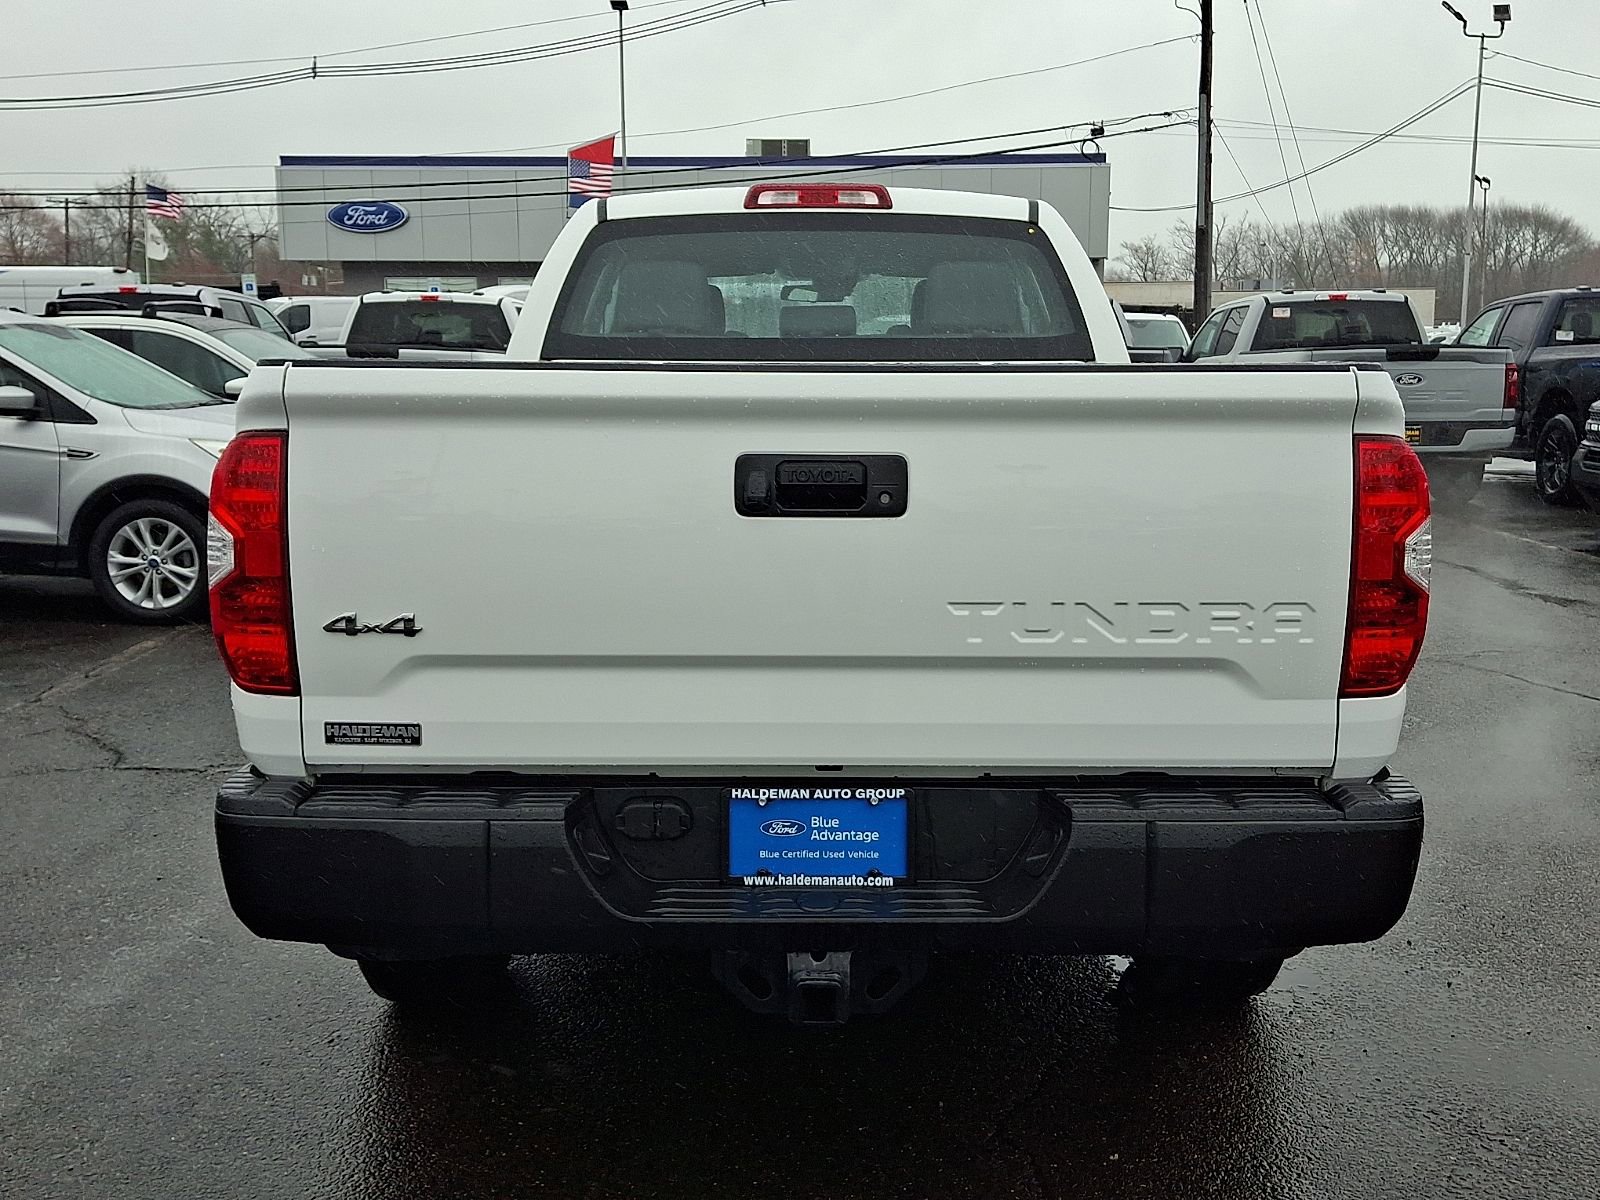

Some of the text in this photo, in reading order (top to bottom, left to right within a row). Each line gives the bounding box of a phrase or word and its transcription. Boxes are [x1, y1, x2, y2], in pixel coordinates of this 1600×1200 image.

[343, 205, 388, 225] Ford
[784, 469, 858, 483] TOYOTA
[947, 601, 1317, 644] TUNDRA
[326, 724, 420, 738] HALDEMAN
[731, 788, 906, 799] HALDEMAN AUTO GROUP
[768, 822, 799, 834] Ford
[811, 816, 839, 828] Blue
[810, 829, 880, 843] Advantage
[759, 850, 880, 859] Blue Certified Used Vehicle
[743, 873, 894, 887] www.haldemanauto.com
